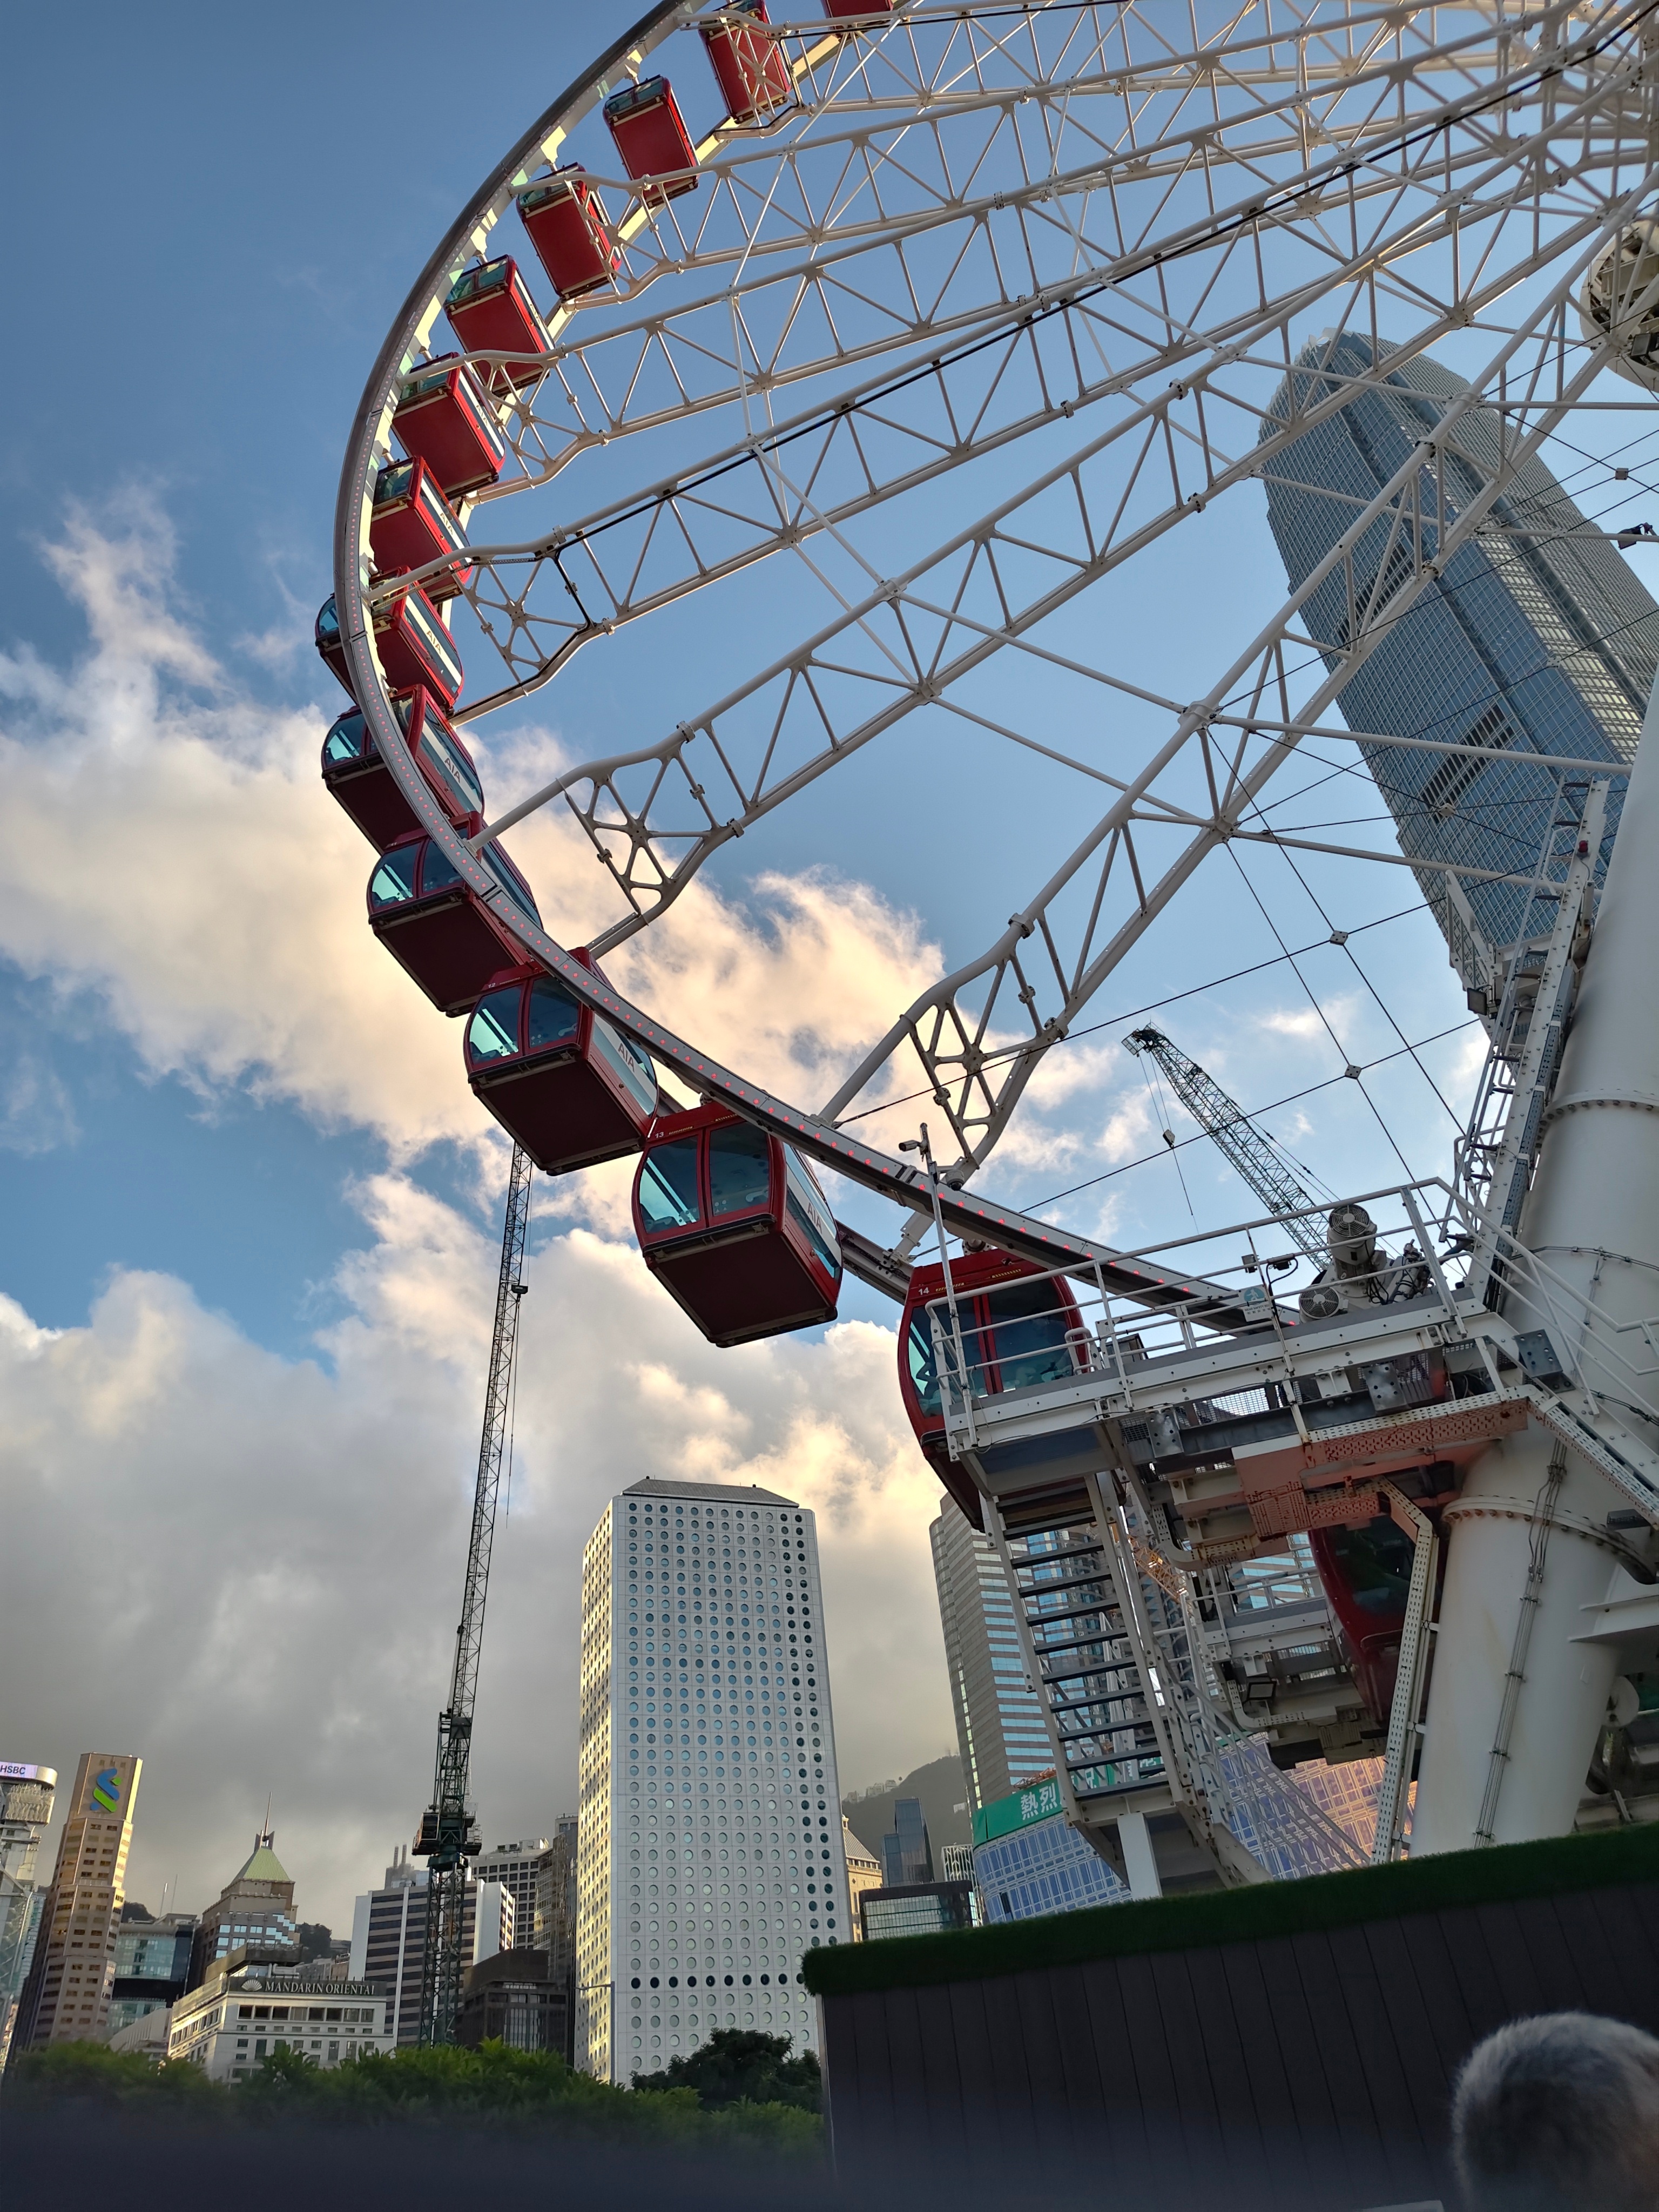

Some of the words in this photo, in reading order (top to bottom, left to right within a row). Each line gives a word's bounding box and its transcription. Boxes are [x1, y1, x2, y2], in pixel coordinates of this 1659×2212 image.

[440, 512, 453, 535] AIA
[426, 630, 441, 655] AIA
[444, 757, 461, 784] AIA
[618, 1042, 635, 1074] AIA
[807, 1202, 823, 1235] AIA
[918, 1287, 930, 1296] 14
[0, 1765, 26, 1775] HSBC
[265, 1980, 324, 1993] MANDARIN
